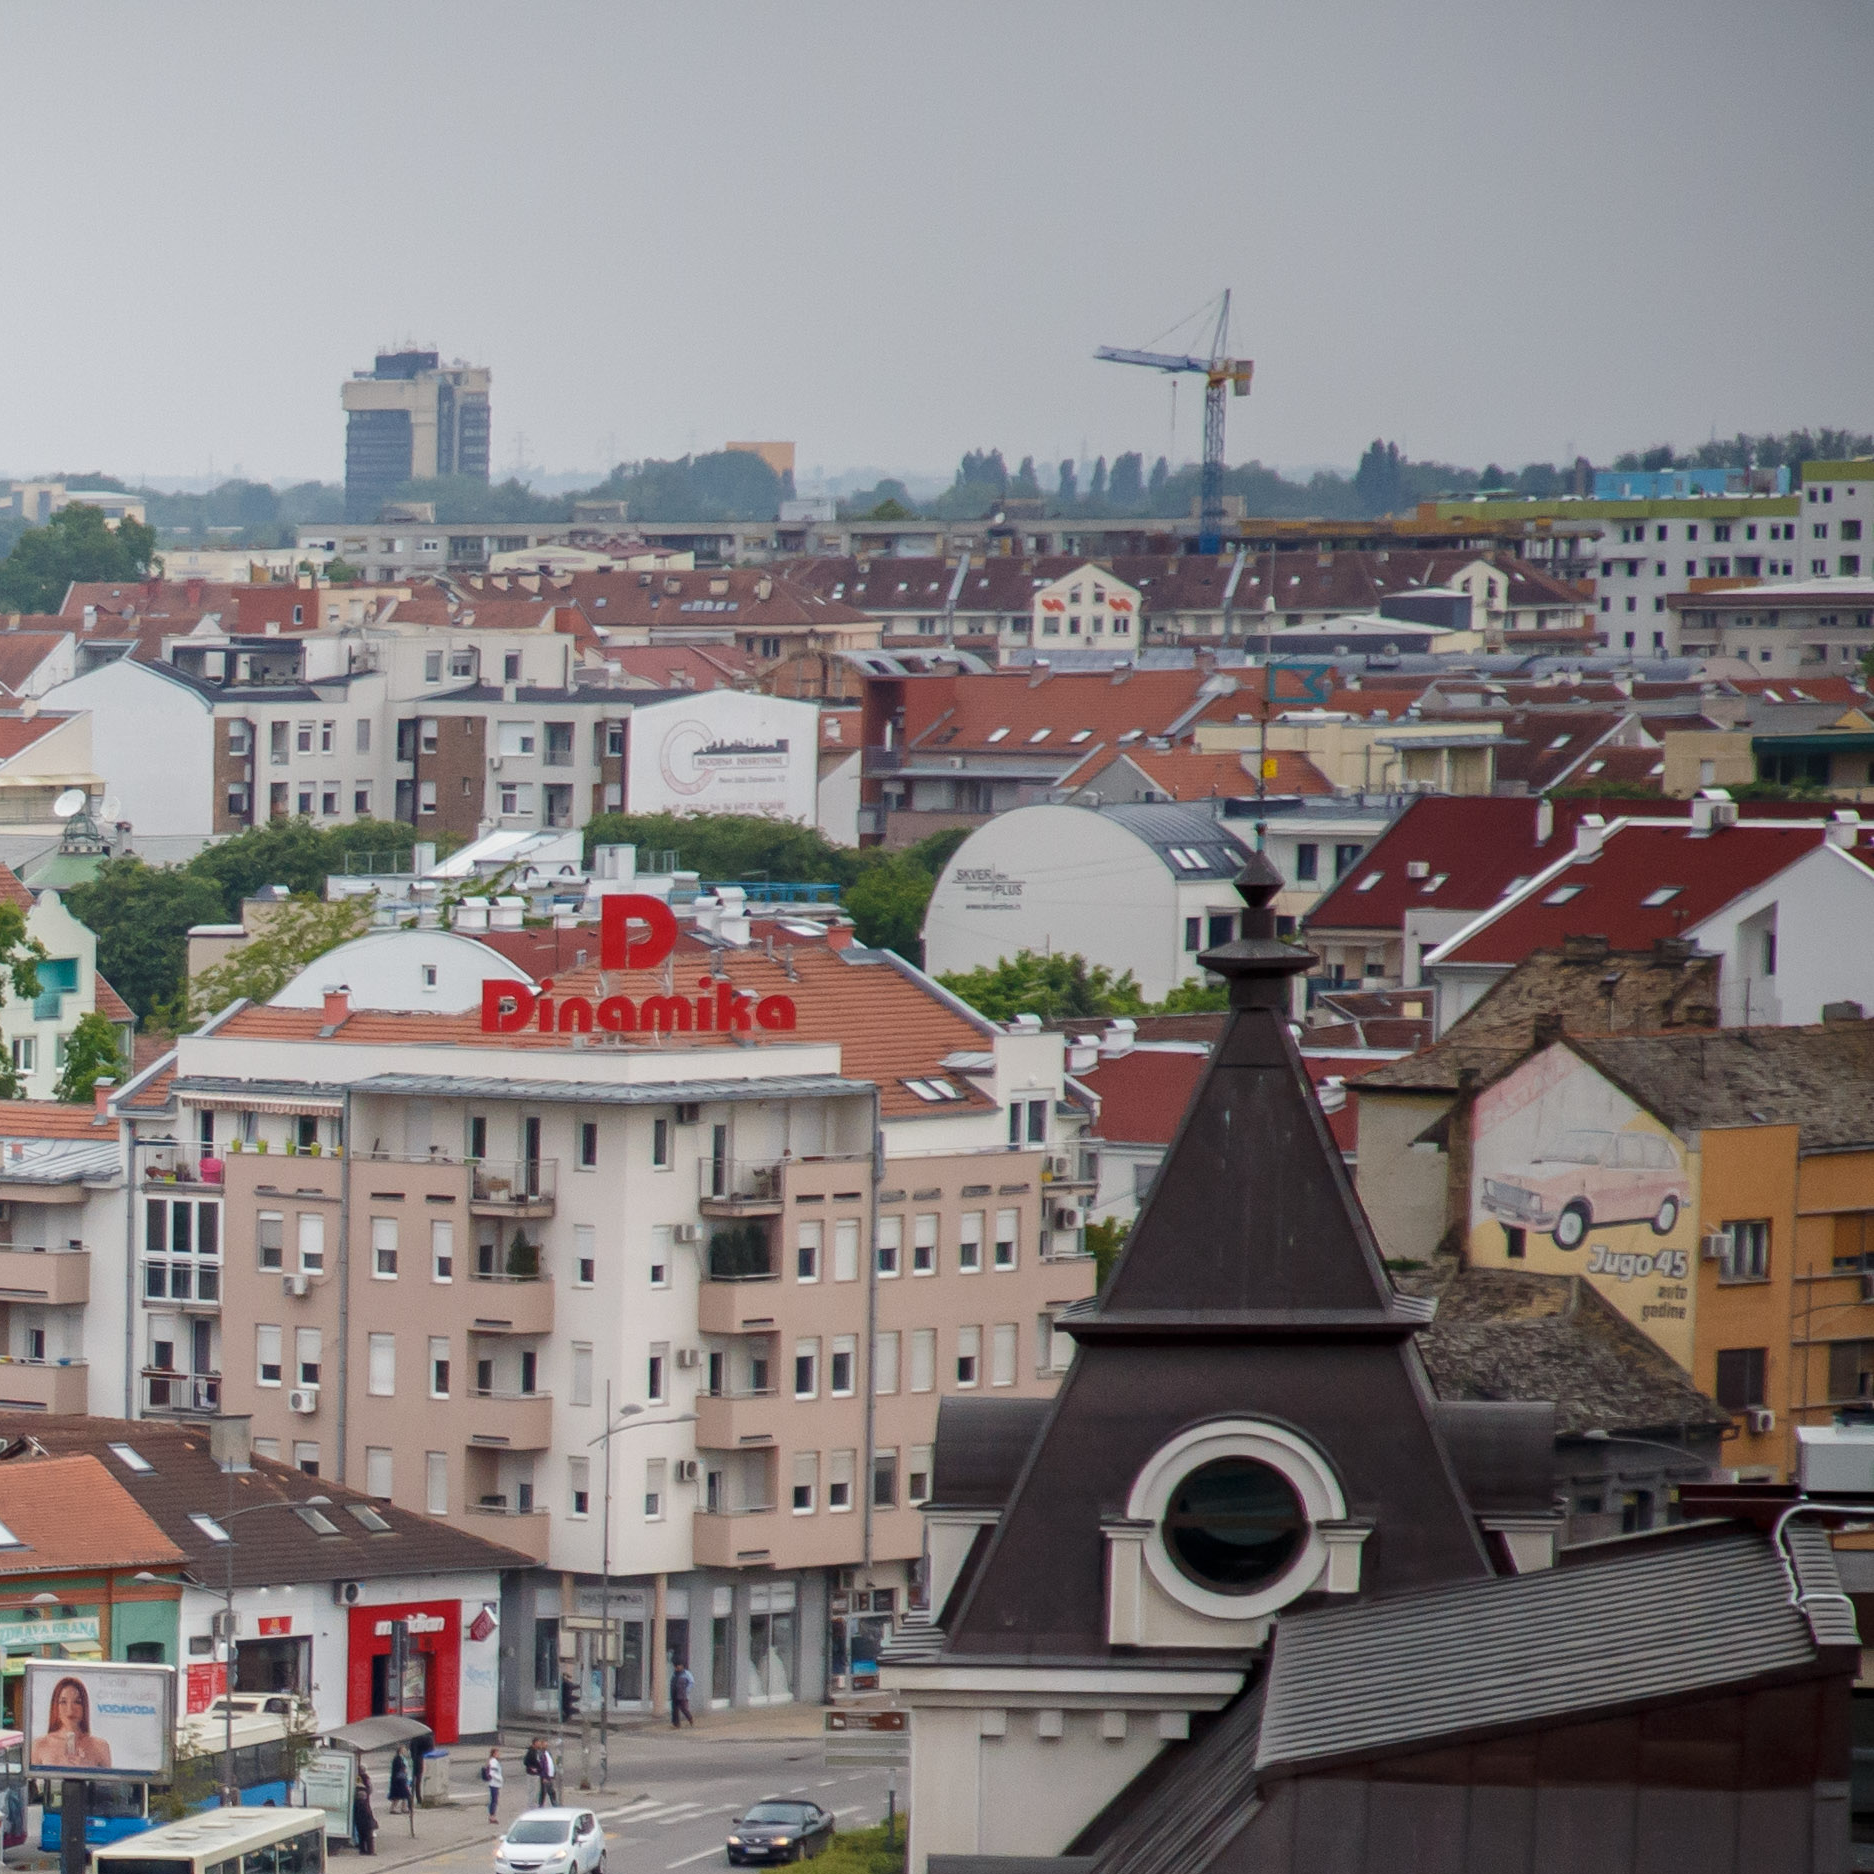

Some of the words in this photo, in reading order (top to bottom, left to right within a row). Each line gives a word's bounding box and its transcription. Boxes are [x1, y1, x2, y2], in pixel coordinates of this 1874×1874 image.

[481, 976, 797, 1033] Dinamika
[1587, 1245, 1654, 1283] Jugo
[1654, 1249, 1689, 1280] 45
